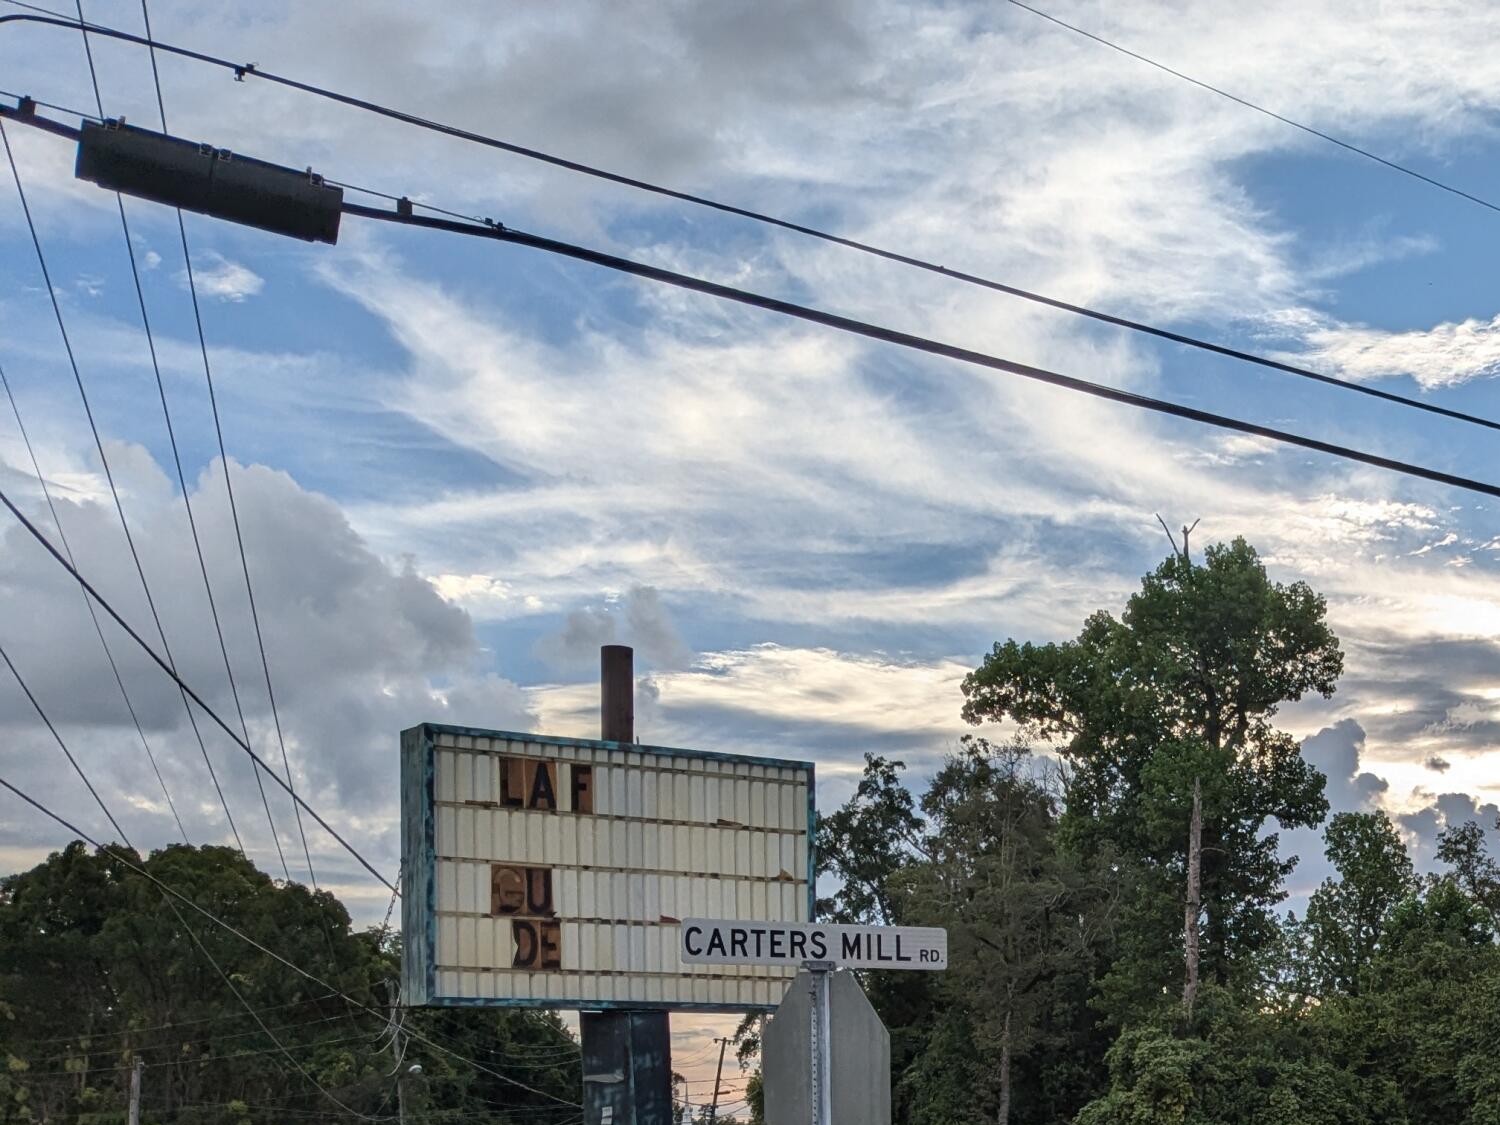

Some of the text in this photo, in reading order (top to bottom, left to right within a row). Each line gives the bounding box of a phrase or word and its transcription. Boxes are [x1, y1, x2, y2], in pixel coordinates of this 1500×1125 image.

[512, 921, 560, 969] DE
[685, 926, 827, 960] CARTERS
[842, 932, 911, 961] MILL
